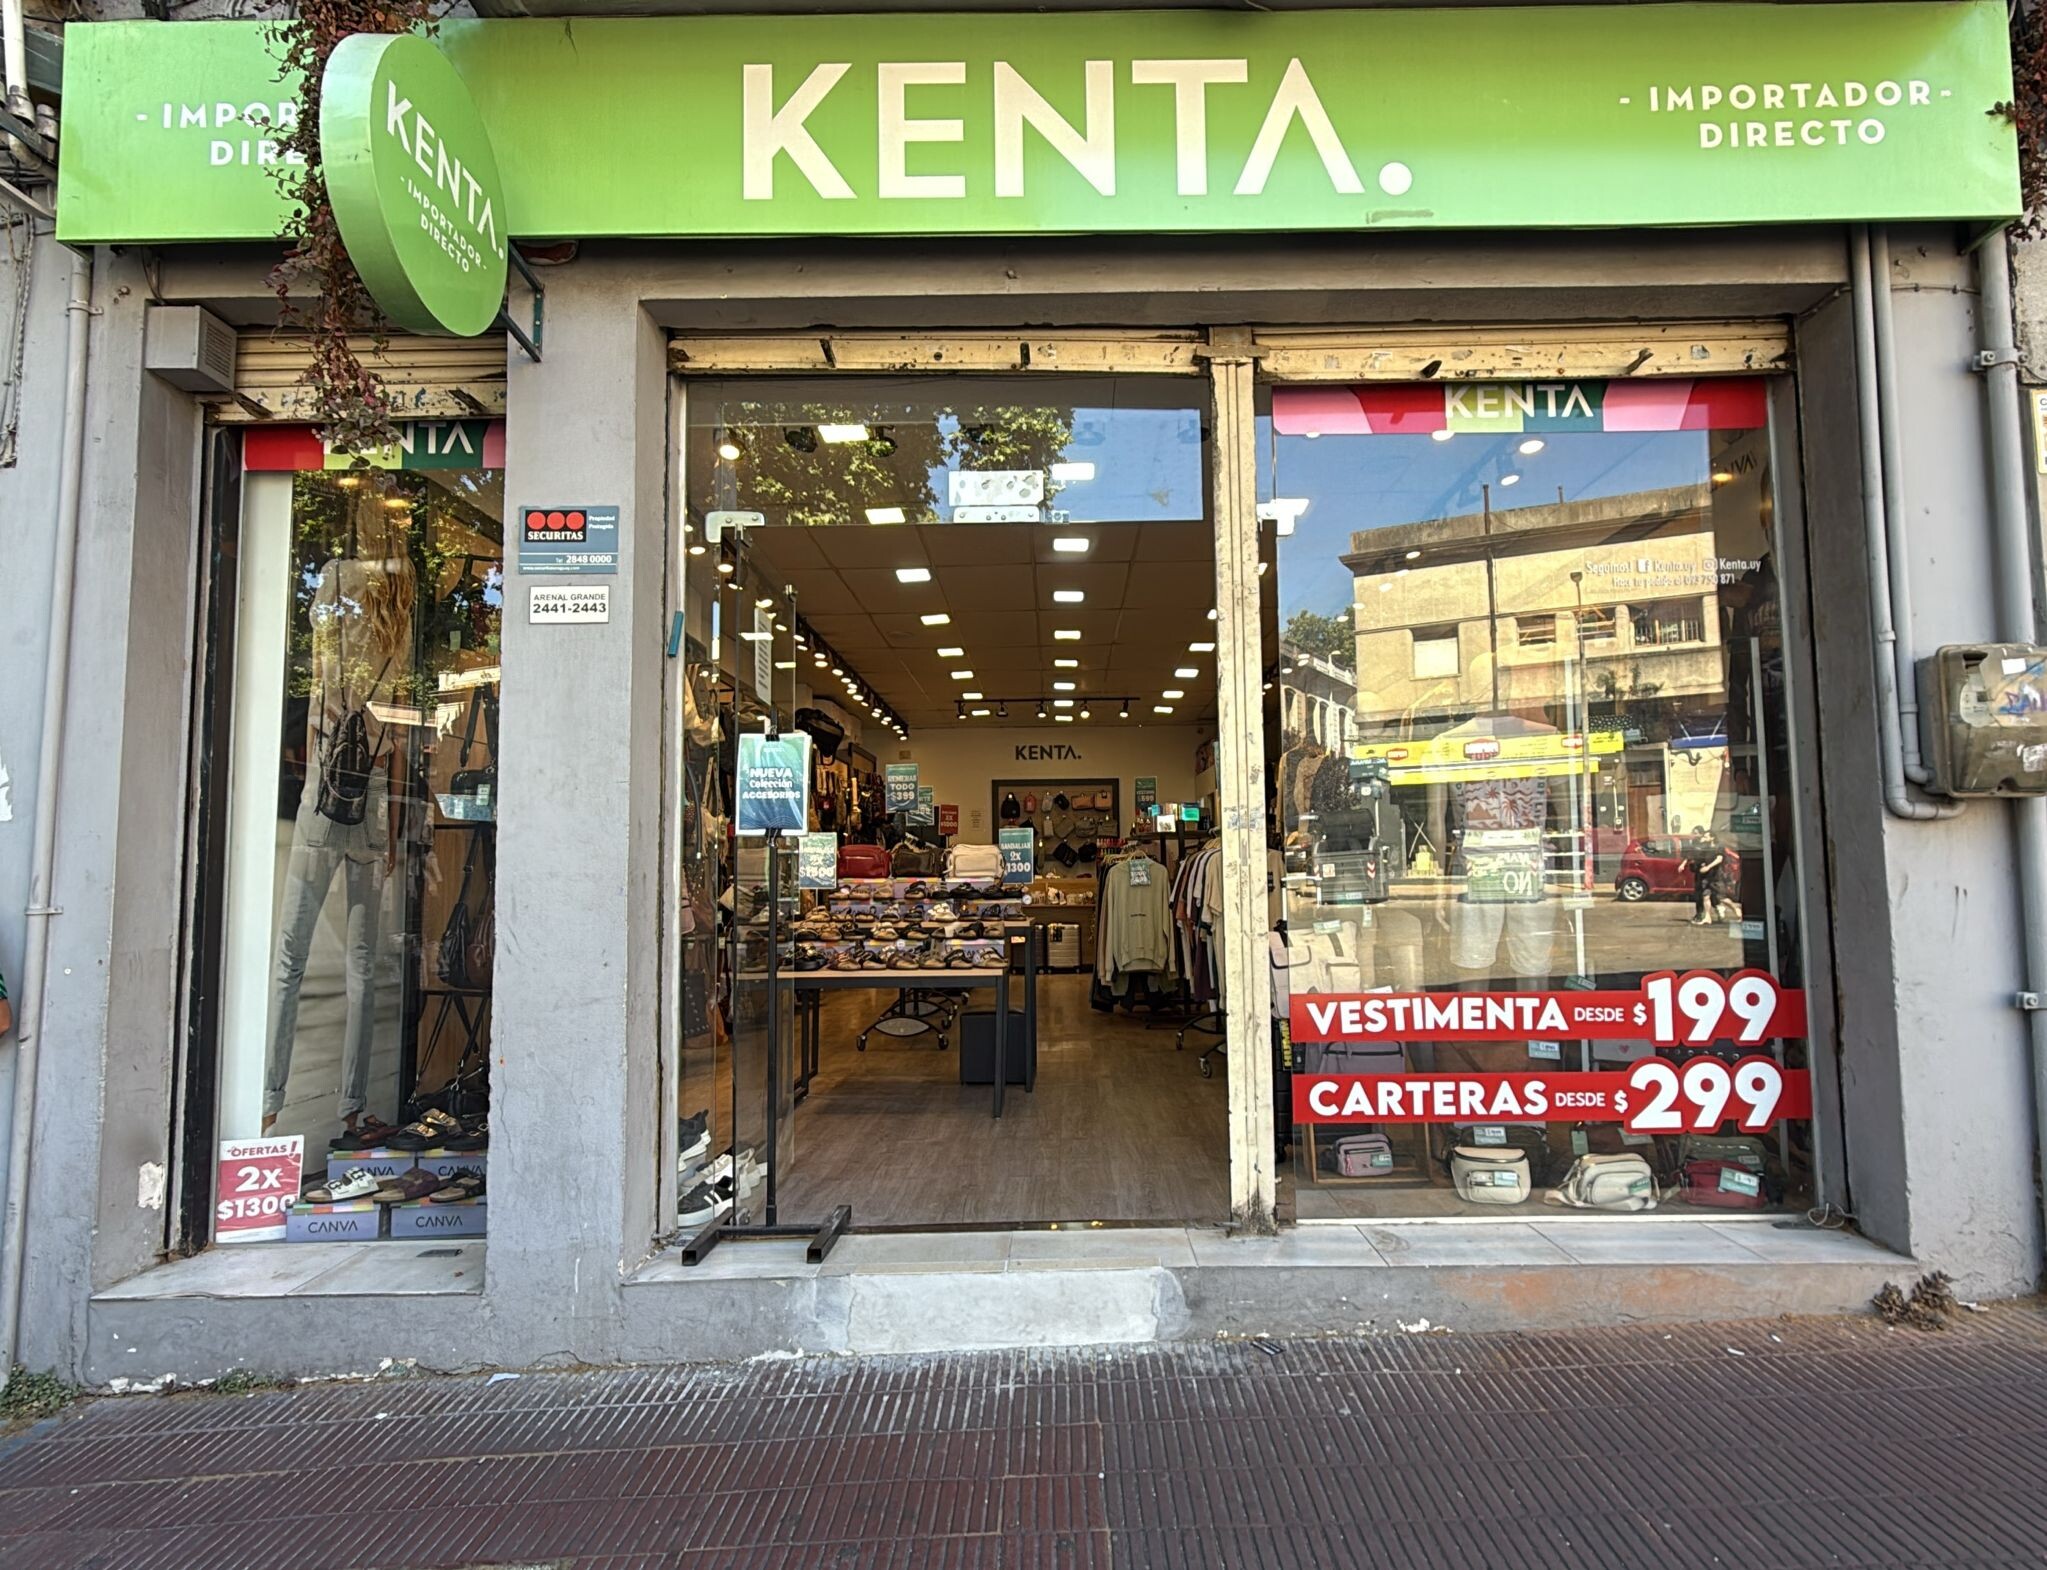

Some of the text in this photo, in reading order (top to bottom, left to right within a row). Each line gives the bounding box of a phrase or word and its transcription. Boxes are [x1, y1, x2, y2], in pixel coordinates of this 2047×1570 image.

[1650, 80, 1931, 111] IMPORTADOR
[1699, 118, 1886, 149] DIRECTO
[407, 178, 482, 269] IMPORTADOR
[420, 213, 470, 273] DIRECTO
[1444, 384, 1594, 419] KENTA
[527, 531, 584, 541] SECURITAS
[565, 555, 588, 563] 2848
[589, 554, 613, 563] 0000
[1719, 557, 1762, 571] Kenta.uy
[1719, 573, 1736, 584] 871
[533, 593, 607, 601] ARENAL GRANDE
[532, 602, 607, 614] 2441-2443
[749, 768, 793, 778] NUEVA
[742, 791, 801, 800] ACCESORIOS
[890, 791, 915, 801] $399
[1005, 862, 1031, 873] 1300
[1305, 996, 1570, 1036] VESTIMENTA
[1574, 1007, 1625, 1022] DESDE
[1308, 1080, 1549, 1116] CARTERAS
[1555, 1092, 1606, 1107] DESDE
[307, 1220, 359, 1233] CANVA
[415, 1214, 464, 1229] CANVA
